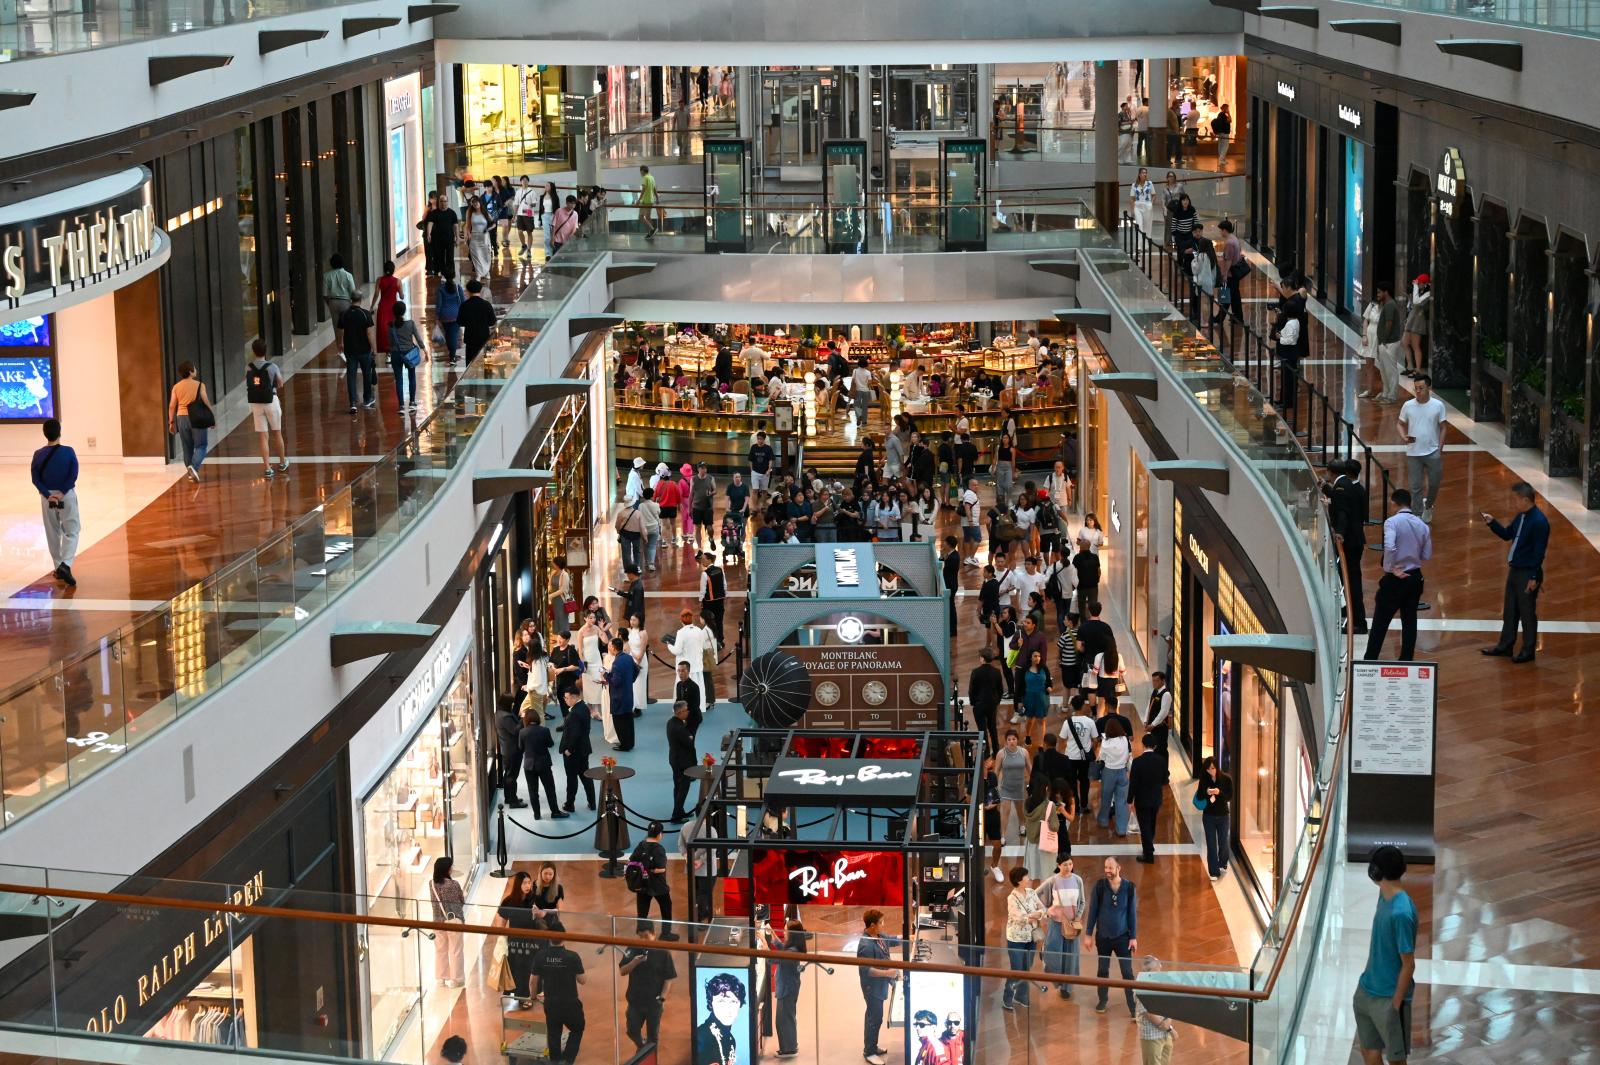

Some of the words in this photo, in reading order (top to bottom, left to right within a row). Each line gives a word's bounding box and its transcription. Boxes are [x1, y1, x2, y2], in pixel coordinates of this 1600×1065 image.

[4, 246, 25, 298] S
[1189, 533, 1209, 575] COACH
[802, 661, 836, 670] OYAGE
[837, 661, 849, 670] OF
[851, 661, 902, 670] PANORAMA
[821, 651, 878, 660] MONTBLANC
[778, 765, 912, 786] Ray-Ban
[789, 858, 867, 898] Ray-Ban
[138, 931, 197, 1007] RALPH
